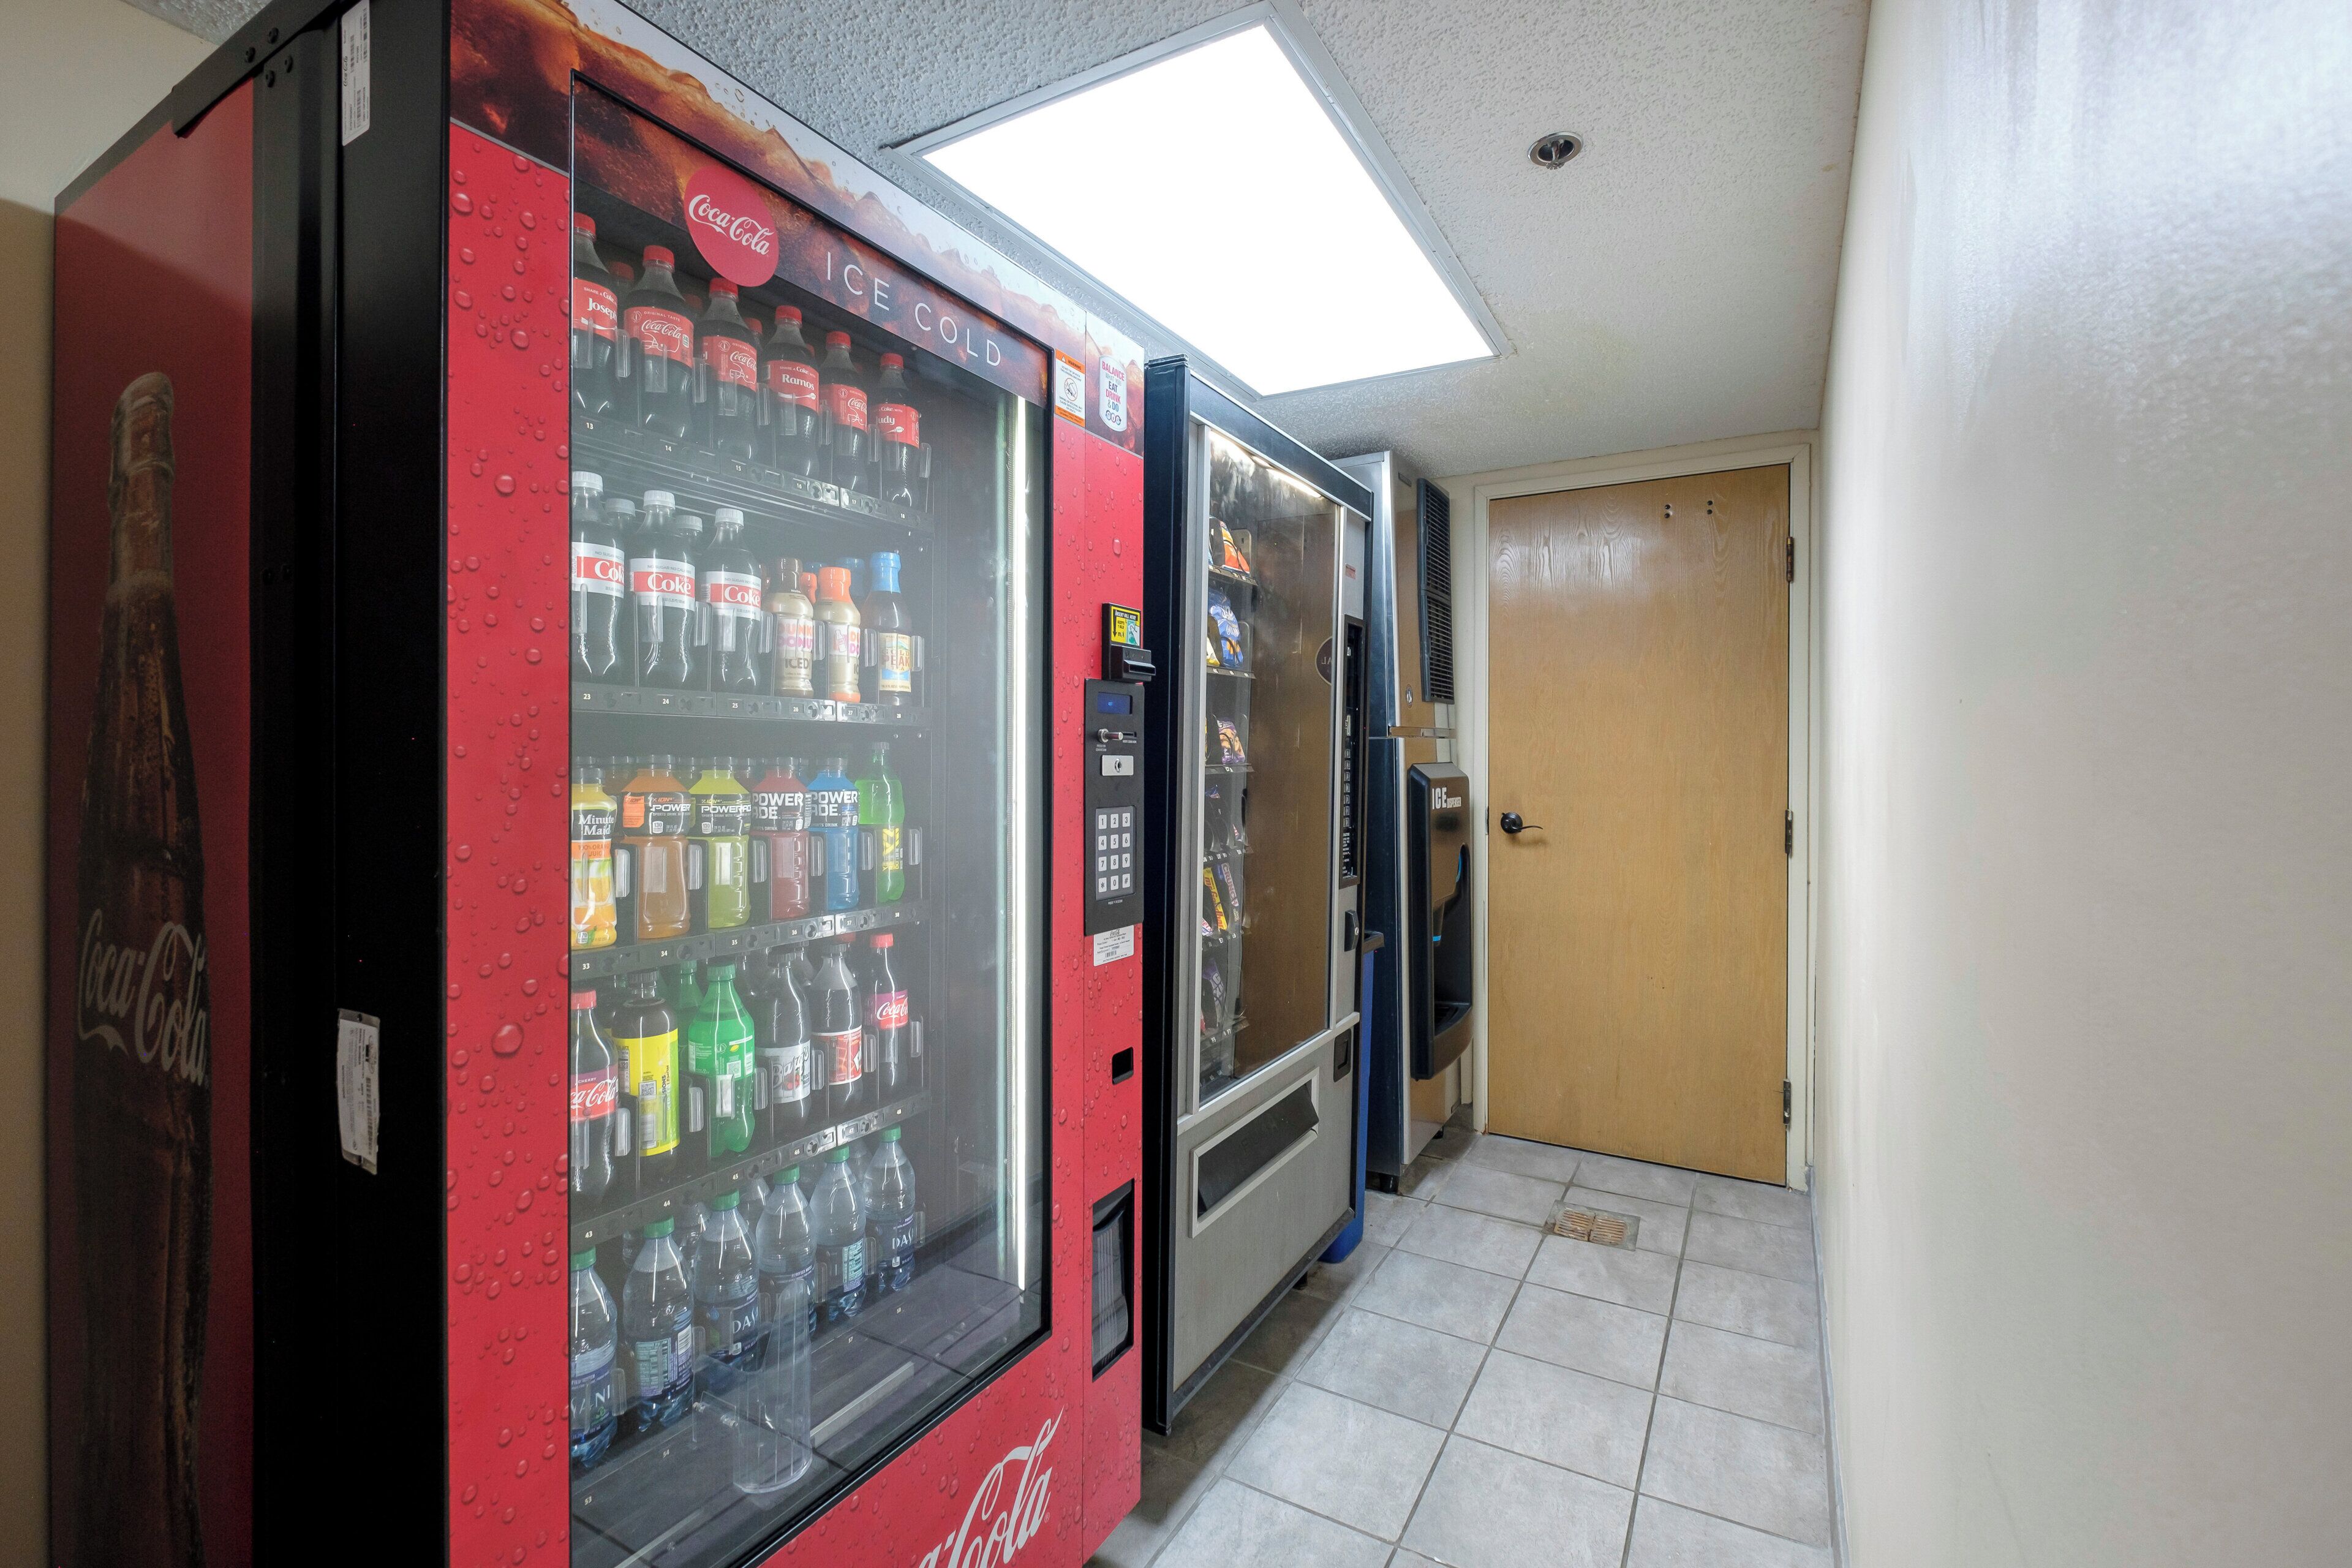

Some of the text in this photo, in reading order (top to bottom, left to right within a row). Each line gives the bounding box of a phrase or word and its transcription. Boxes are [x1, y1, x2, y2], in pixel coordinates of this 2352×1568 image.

[688, 194, 774, 255] Coca-Cola
[827, 252, 1001, 366] ICE COLD
[641, 319, 683, 339] Coca-Cola
[796, 366, 809, 375] Coke
[1102, 361, 1125, 381] BALANCE
[1105, 372, 1115, 381] WHAT
[782, 374, 815, 390] Ramos
[1109, 380, 1118, 393] EAT
[1106, 389, 1121, 404] DRINK
[1107, 399, 1119, 412] & DO
[647, 573, 692, 595] Coke
[724, 586, 760, 606] Coke
[785, 658, 809, 669] ICED
[881, 655, 910, 668] PEAK
[752, 793, 803, 806] POWER
[806, 791, 858, 804] POWER
[1432, 787, 1447, 810] ICE
[578, 814, 614, 825] Minute
[583, 824, 611, 835] Maid
[78, 908, 206, 1086] Coca-Cola
[663, 1449, 670, 1458] 54
[584, 1496, 592, 1506] 53
